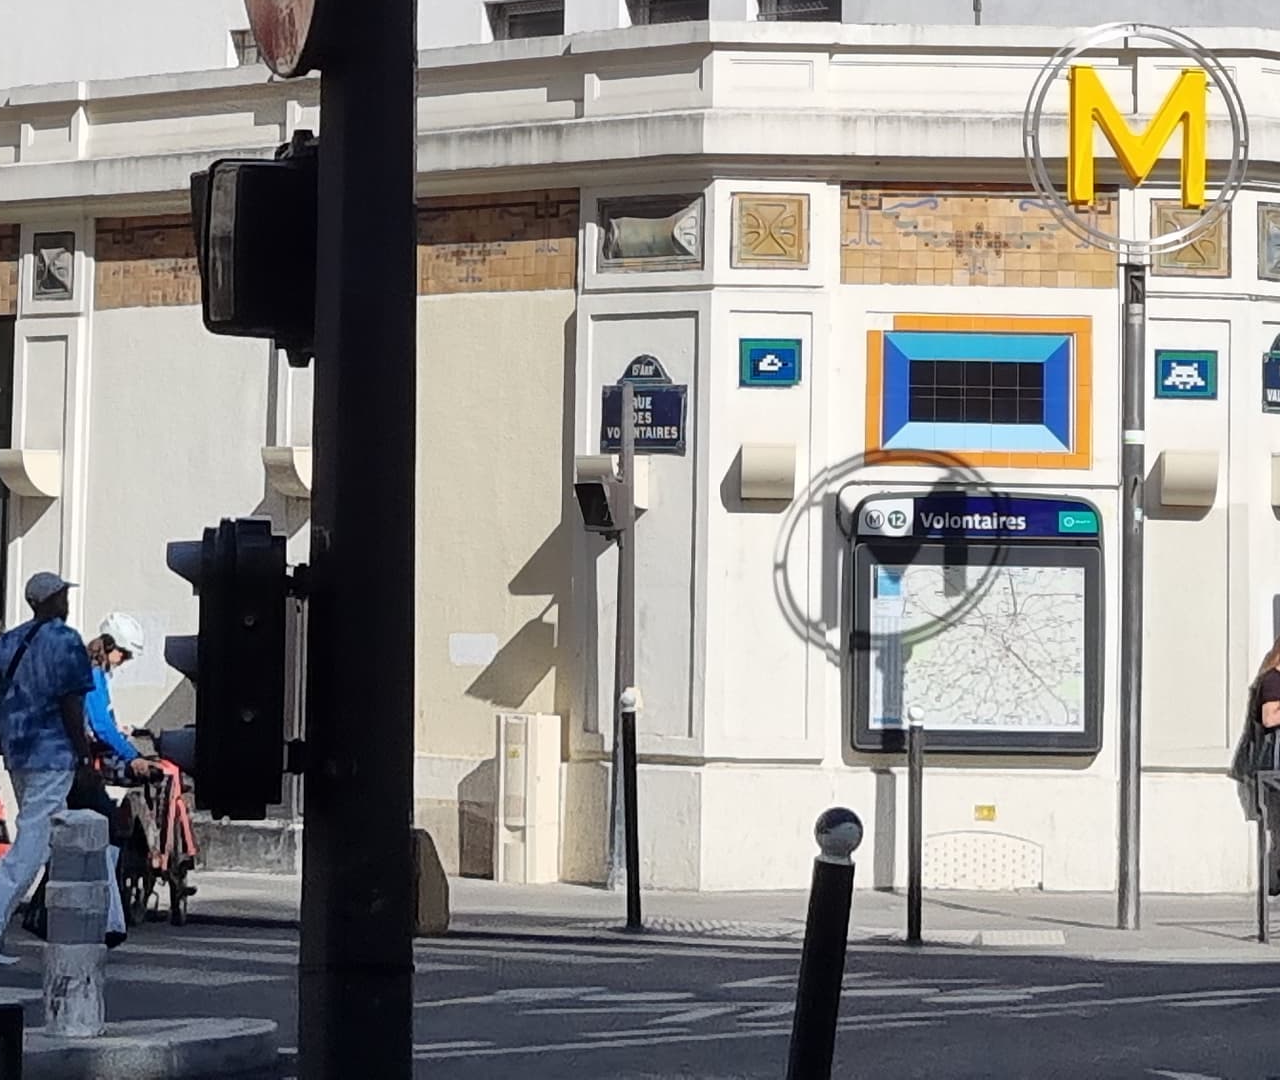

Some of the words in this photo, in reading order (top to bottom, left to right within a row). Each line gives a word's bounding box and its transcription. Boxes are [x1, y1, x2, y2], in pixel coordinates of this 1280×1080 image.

[1067, 65, 1206, 209] M
[607, 426, 678, 439] VONTAIRES
[920, 511, 1026, 531] Volontaires
